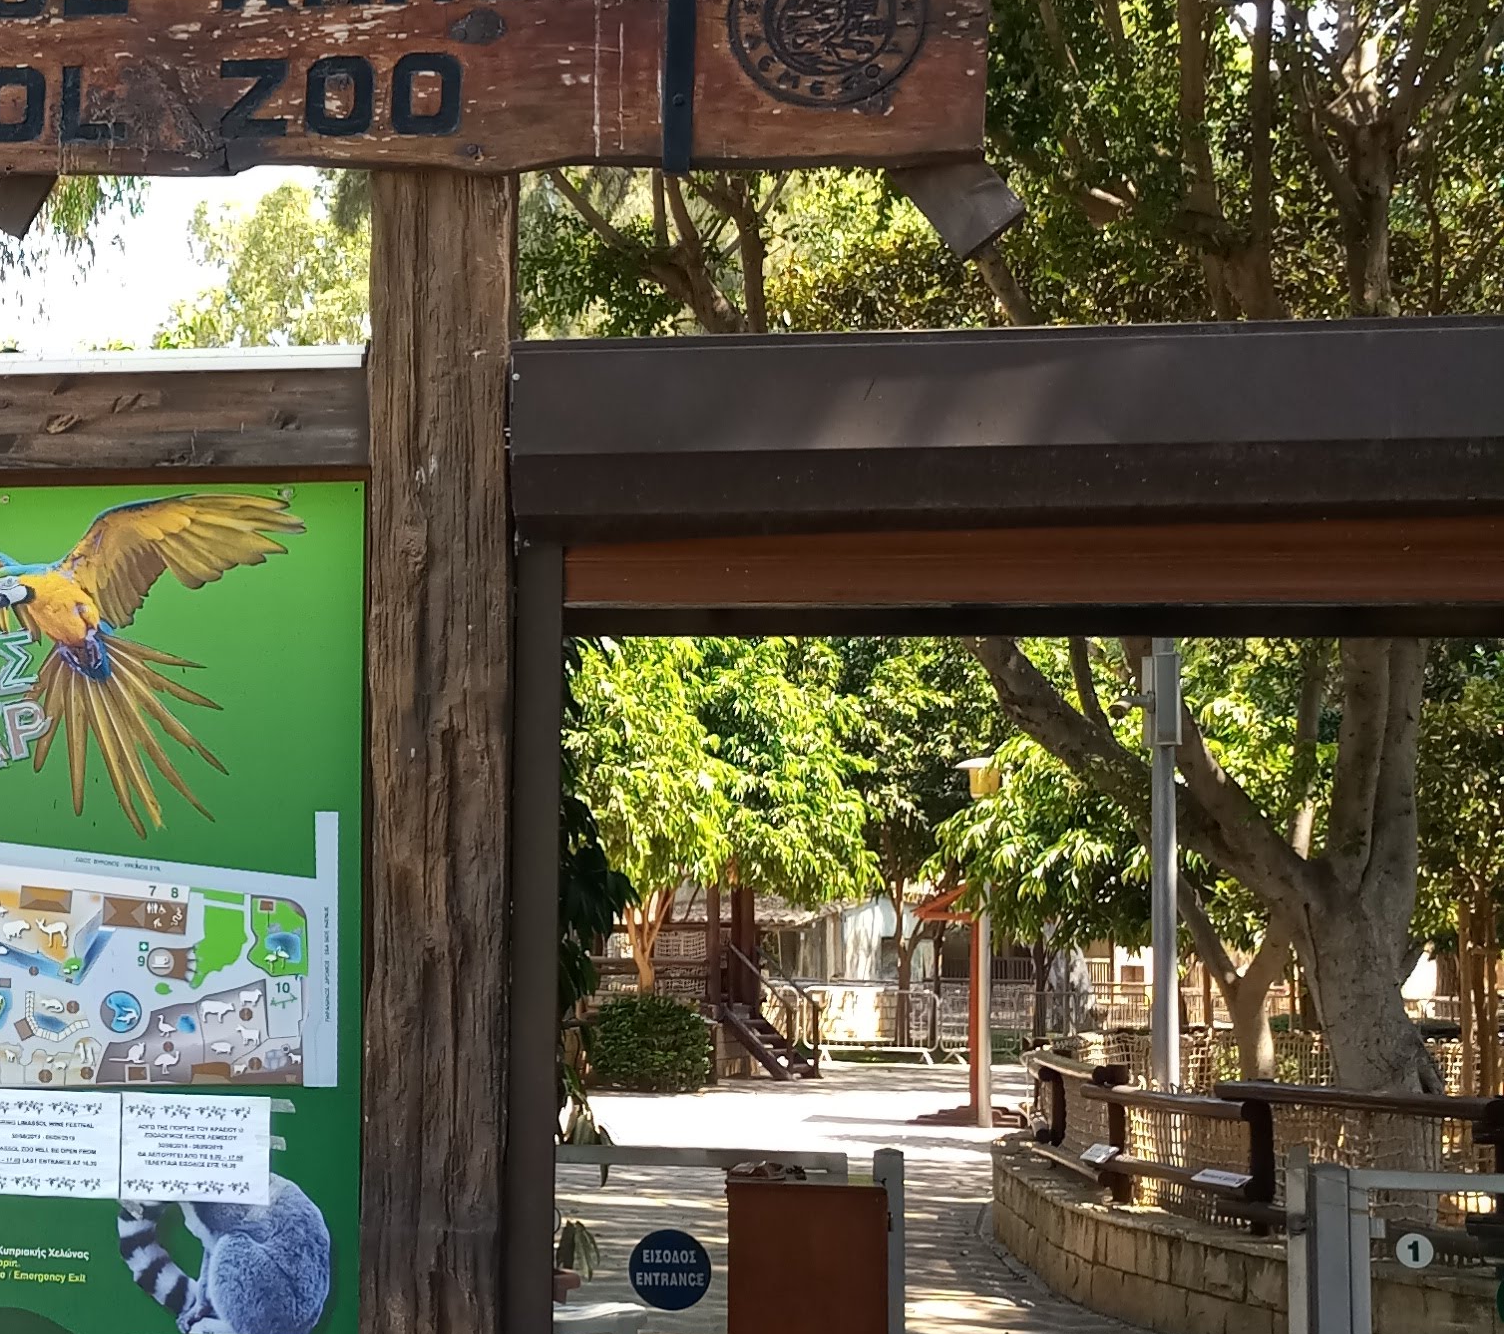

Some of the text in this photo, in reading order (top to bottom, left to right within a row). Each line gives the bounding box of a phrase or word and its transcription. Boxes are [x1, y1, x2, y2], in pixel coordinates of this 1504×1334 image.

[218, 51, 465, 138] ZOO
[148, 885, 157, 897] 7
[170, 887, 180, 898] 8
[137, 955, 146, 967] 9
[275, 982, 291, 994] 10
[48, 1248, 90, 1261] Χελώνας
[642, 1249, 697, 1264] ΕΙΣΟΔΟΣ
[1407, 1240, 1420, 1262] 1
[13, 1270, 66, 1283] Emergency
[68, 1273, 86, 1283] Exit
[636, 1272, 705, 1287] ENTRANCE
